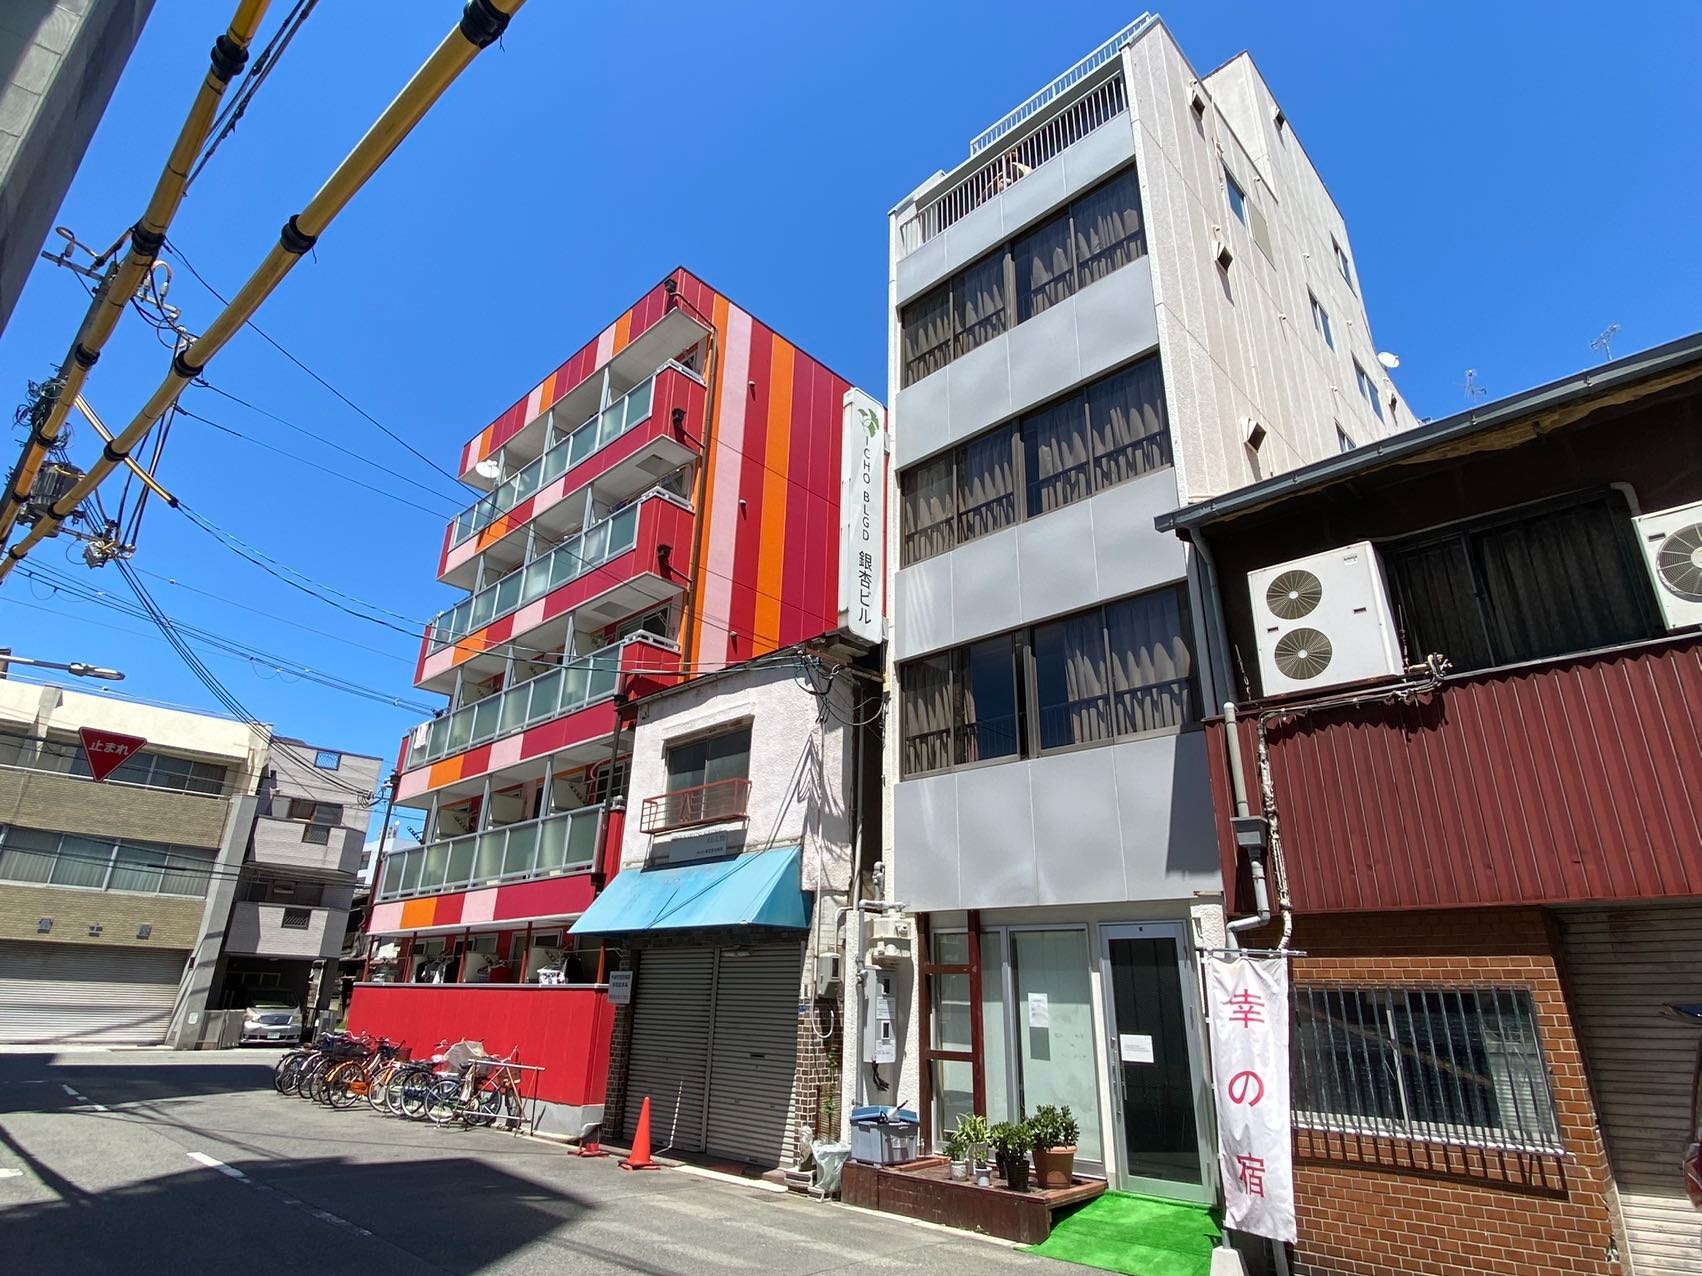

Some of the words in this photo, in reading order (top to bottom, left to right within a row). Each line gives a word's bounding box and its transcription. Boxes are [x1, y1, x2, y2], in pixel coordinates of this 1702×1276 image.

[863, 436, 871, 484] ICHO
[859, 551, 873, 625] 銀杏ビル
[89, 741, 129, 755] 止まれ
[1228, 988, 1266, 1198] 幸の宿
